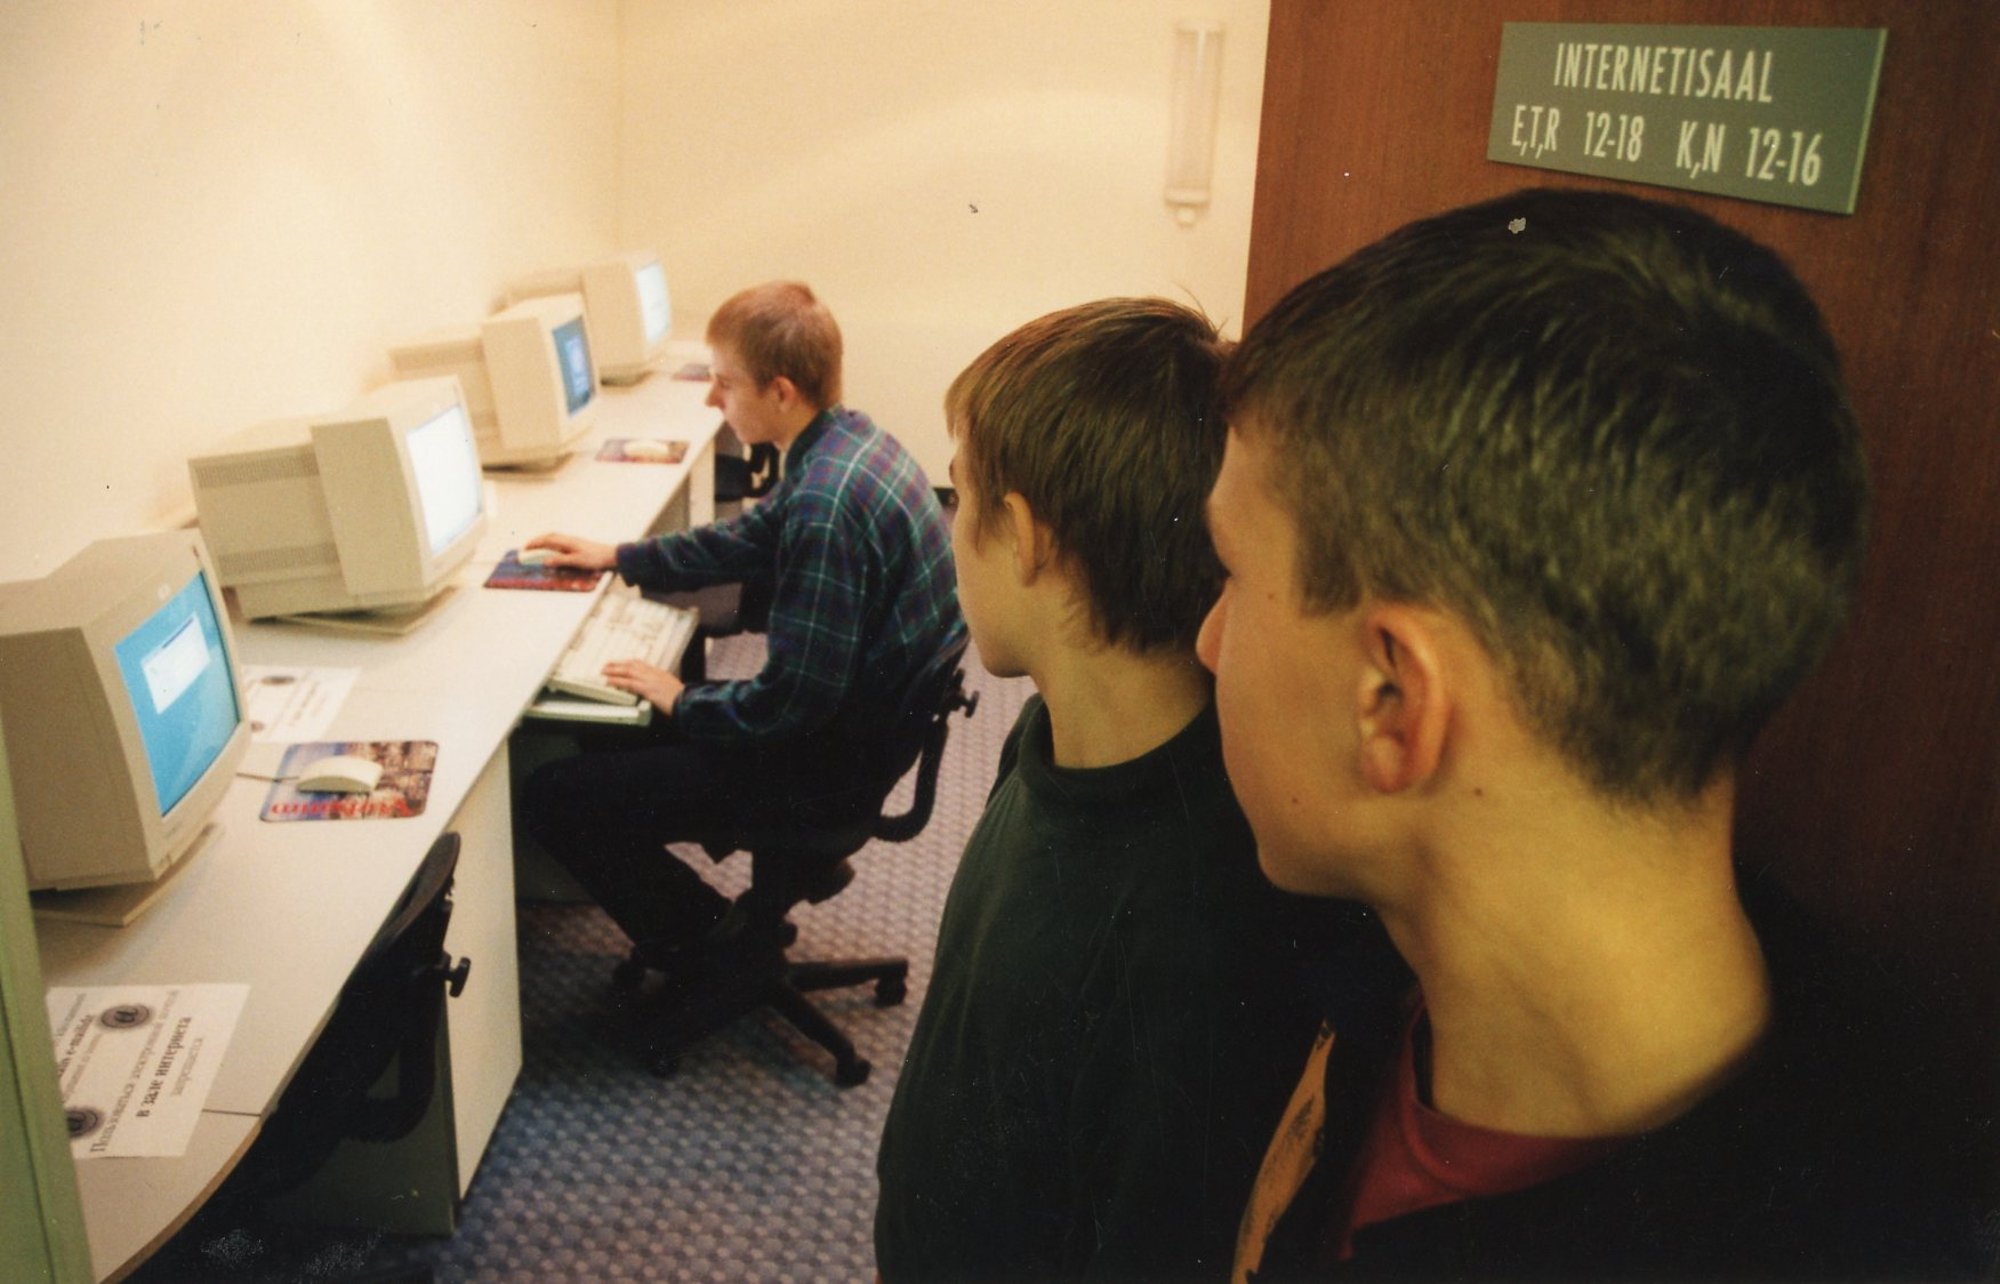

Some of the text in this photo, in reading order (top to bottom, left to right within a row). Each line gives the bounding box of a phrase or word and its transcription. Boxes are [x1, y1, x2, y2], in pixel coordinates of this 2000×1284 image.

[1553, 42, 1775, 103] INTERNETISAAL
[1511, 105, 1824, 188] E,T,R 12-18 K,N 12-16
[154, 1016, 193, 1078] интернета
